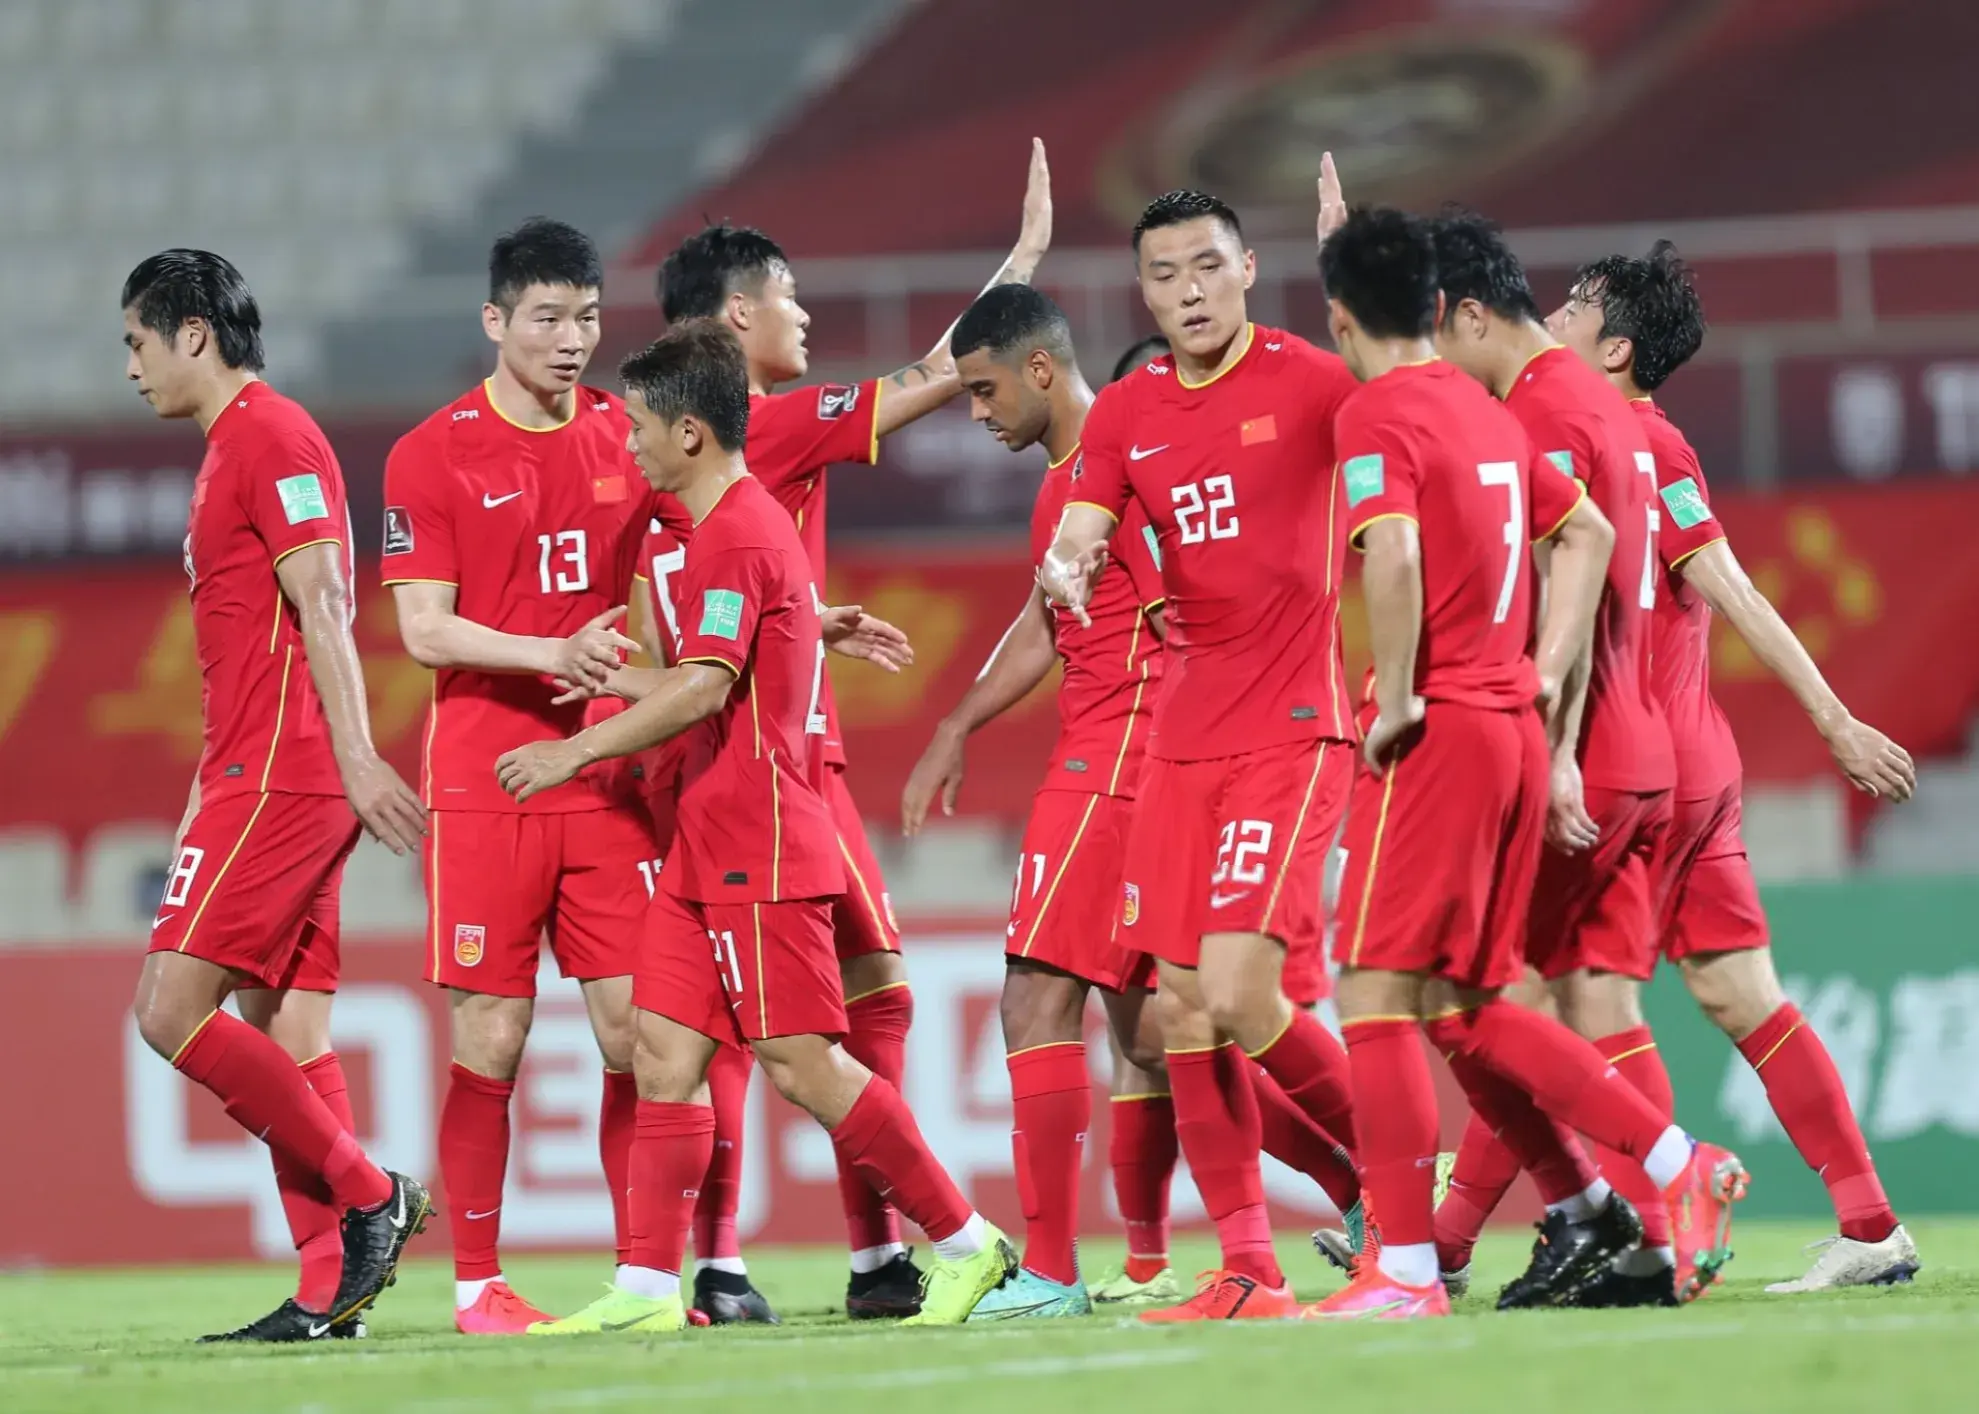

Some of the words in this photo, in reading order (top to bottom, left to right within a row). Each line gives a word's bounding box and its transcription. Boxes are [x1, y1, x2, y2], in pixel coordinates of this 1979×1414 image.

[1171, 474, 1239, 545] 22
[1476, 461, 1524, 624] 7
[538, 529, 589, 594] 13
[161, 846, 205, 907] 8
[1211, 819, 1273, 885] 22
